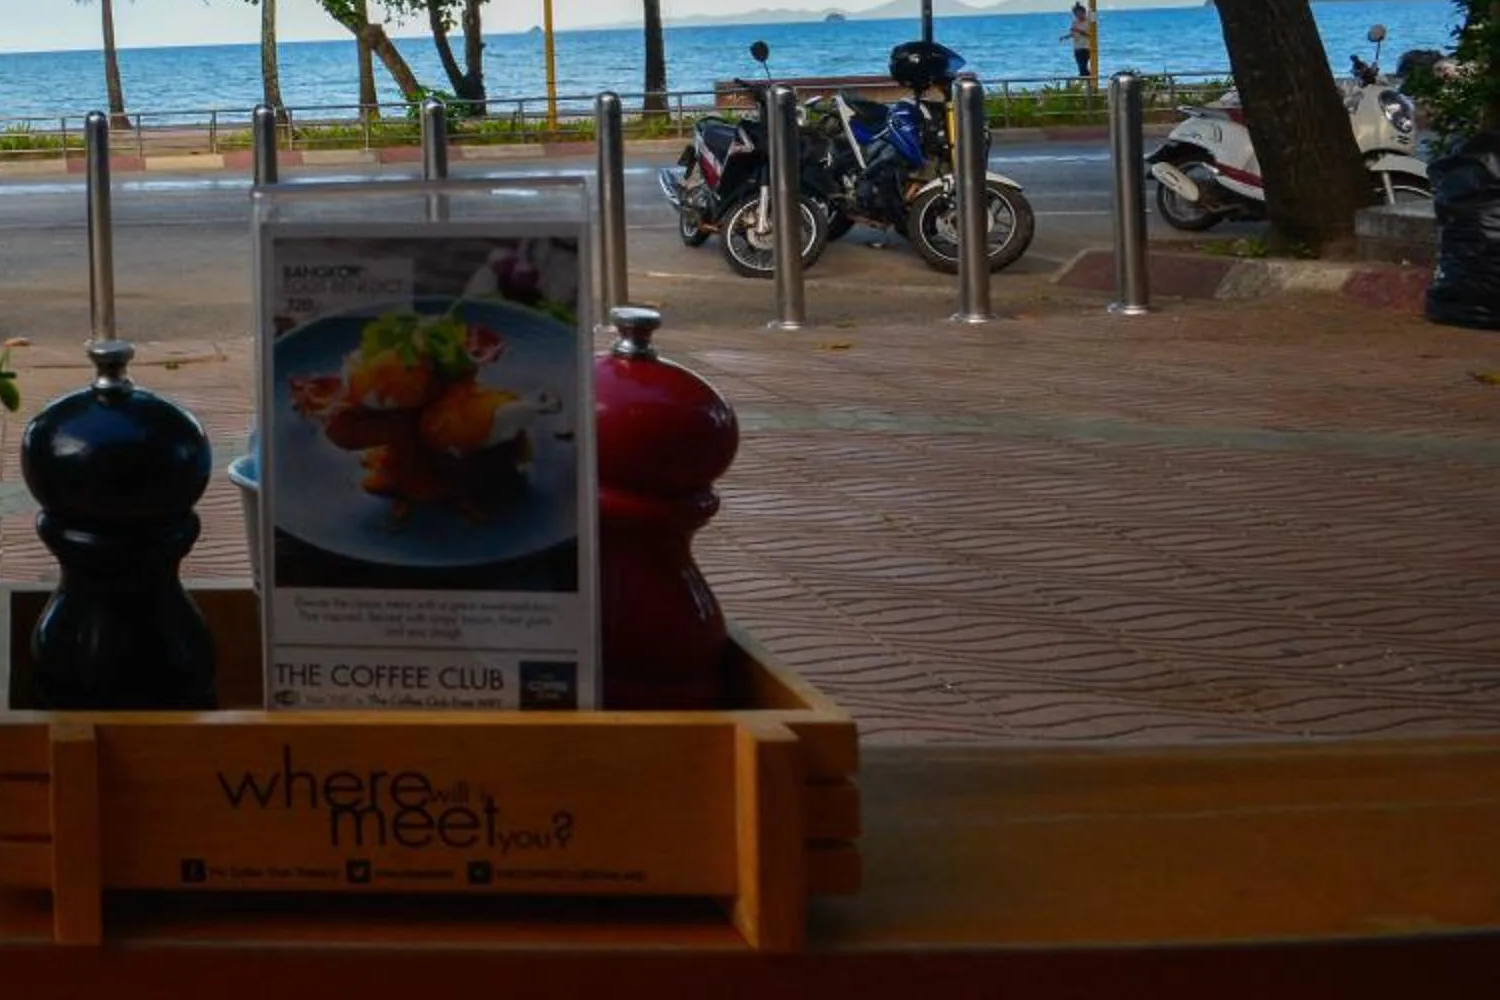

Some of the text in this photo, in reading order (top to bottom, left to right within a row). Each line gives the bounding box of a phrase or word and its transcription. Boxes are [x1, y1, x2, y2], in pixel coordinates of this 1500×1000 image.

[274, 663, 322, 687] THE
[330, 664, 430, 690] COFFEE
[438, 665, 504, 692] CLUB
[216, 743, 432, 809] where
[330, 794, 576, 858] meet you?
